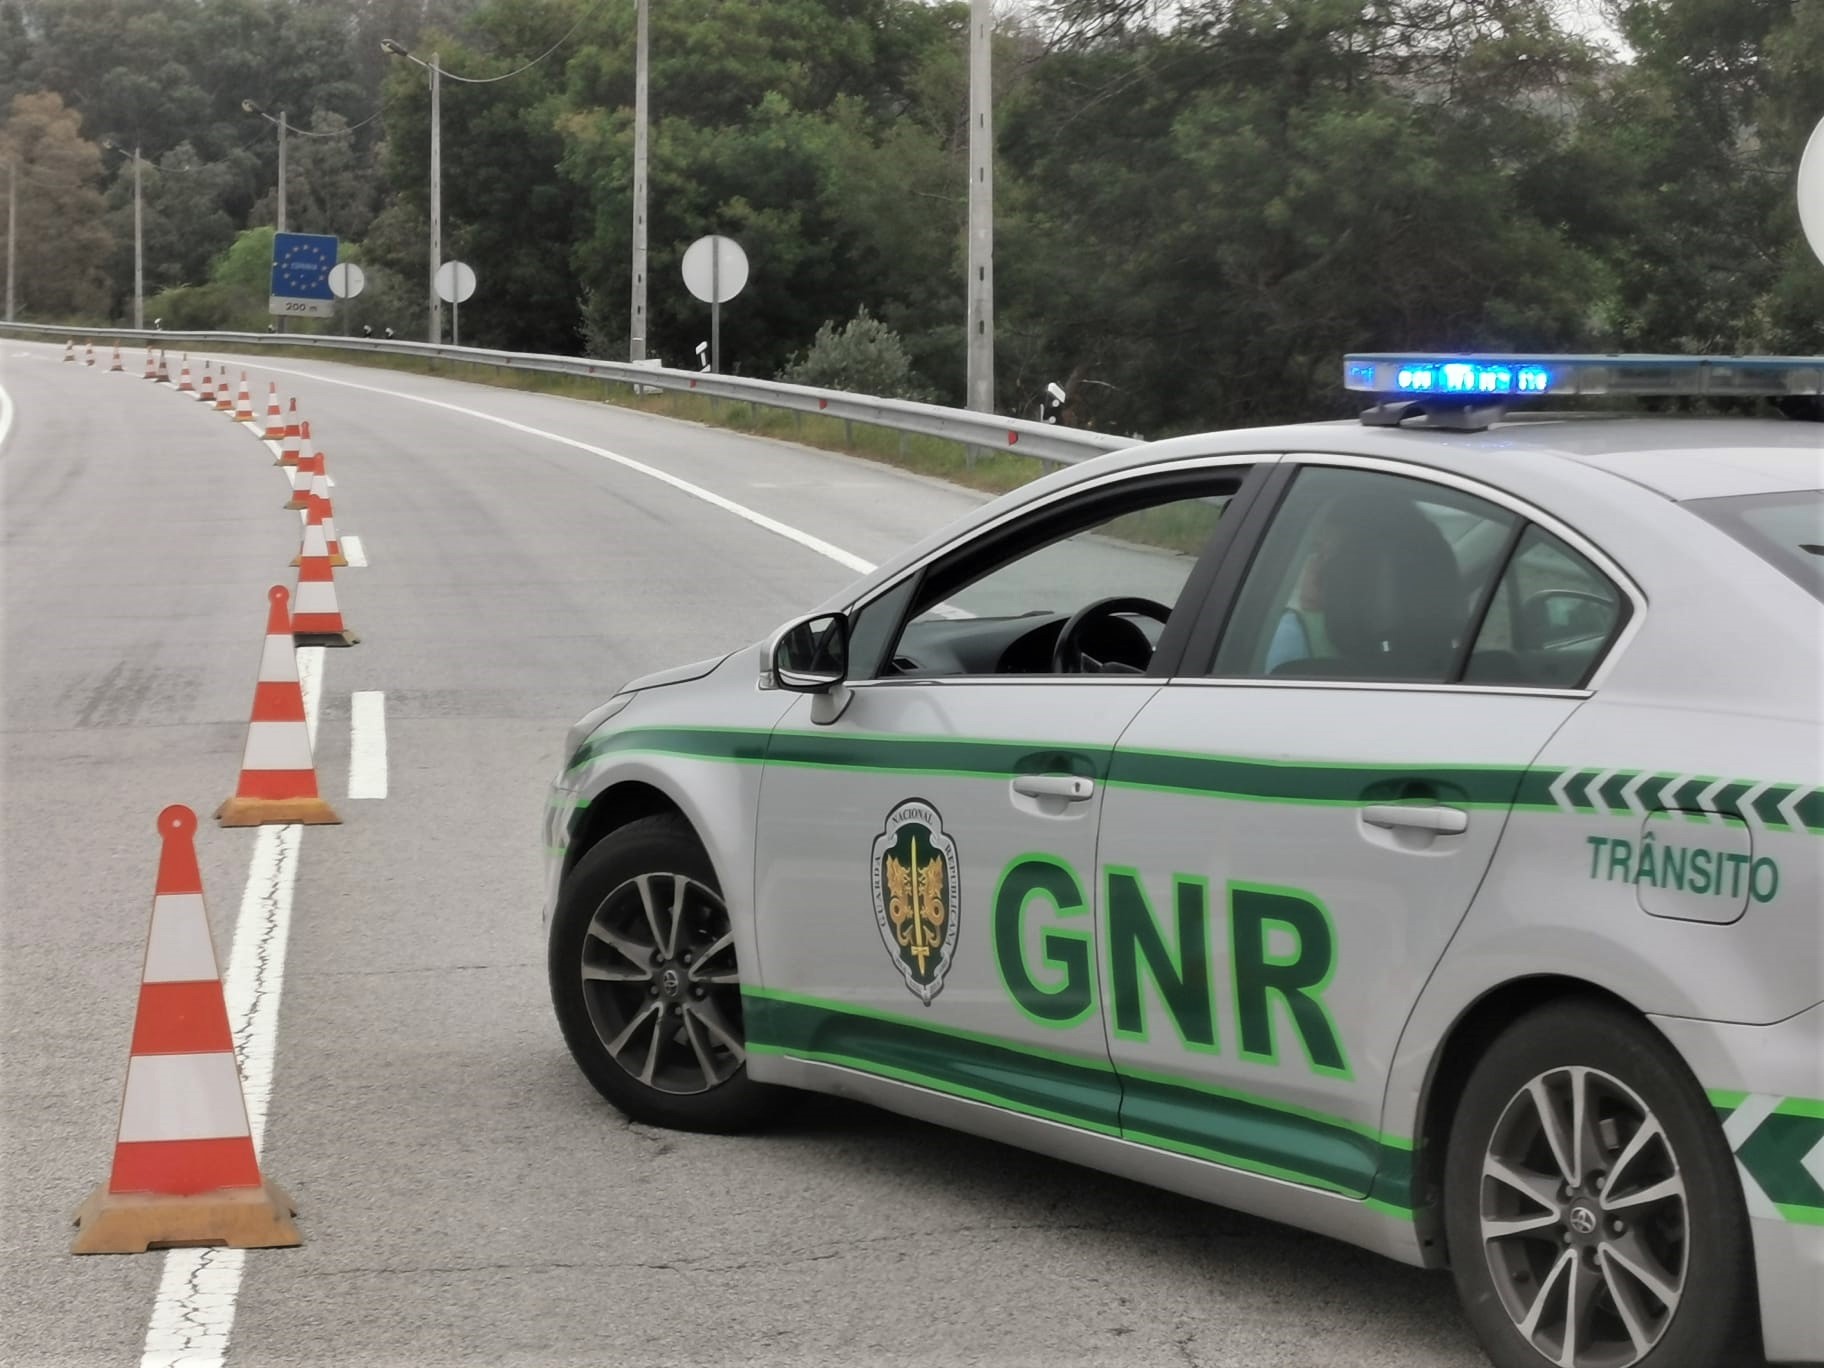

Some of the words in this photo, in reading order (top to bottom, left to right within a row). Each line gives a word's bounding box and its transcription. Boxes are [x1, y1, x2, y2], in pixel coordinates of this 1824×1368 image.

[285, 302, 306, 311] 200
[891, 807, 934, 826] NACIONAL
[1587, 831, 1779, 903] TRÂNSITO
[992, 853, 1354, 1081] GNR
